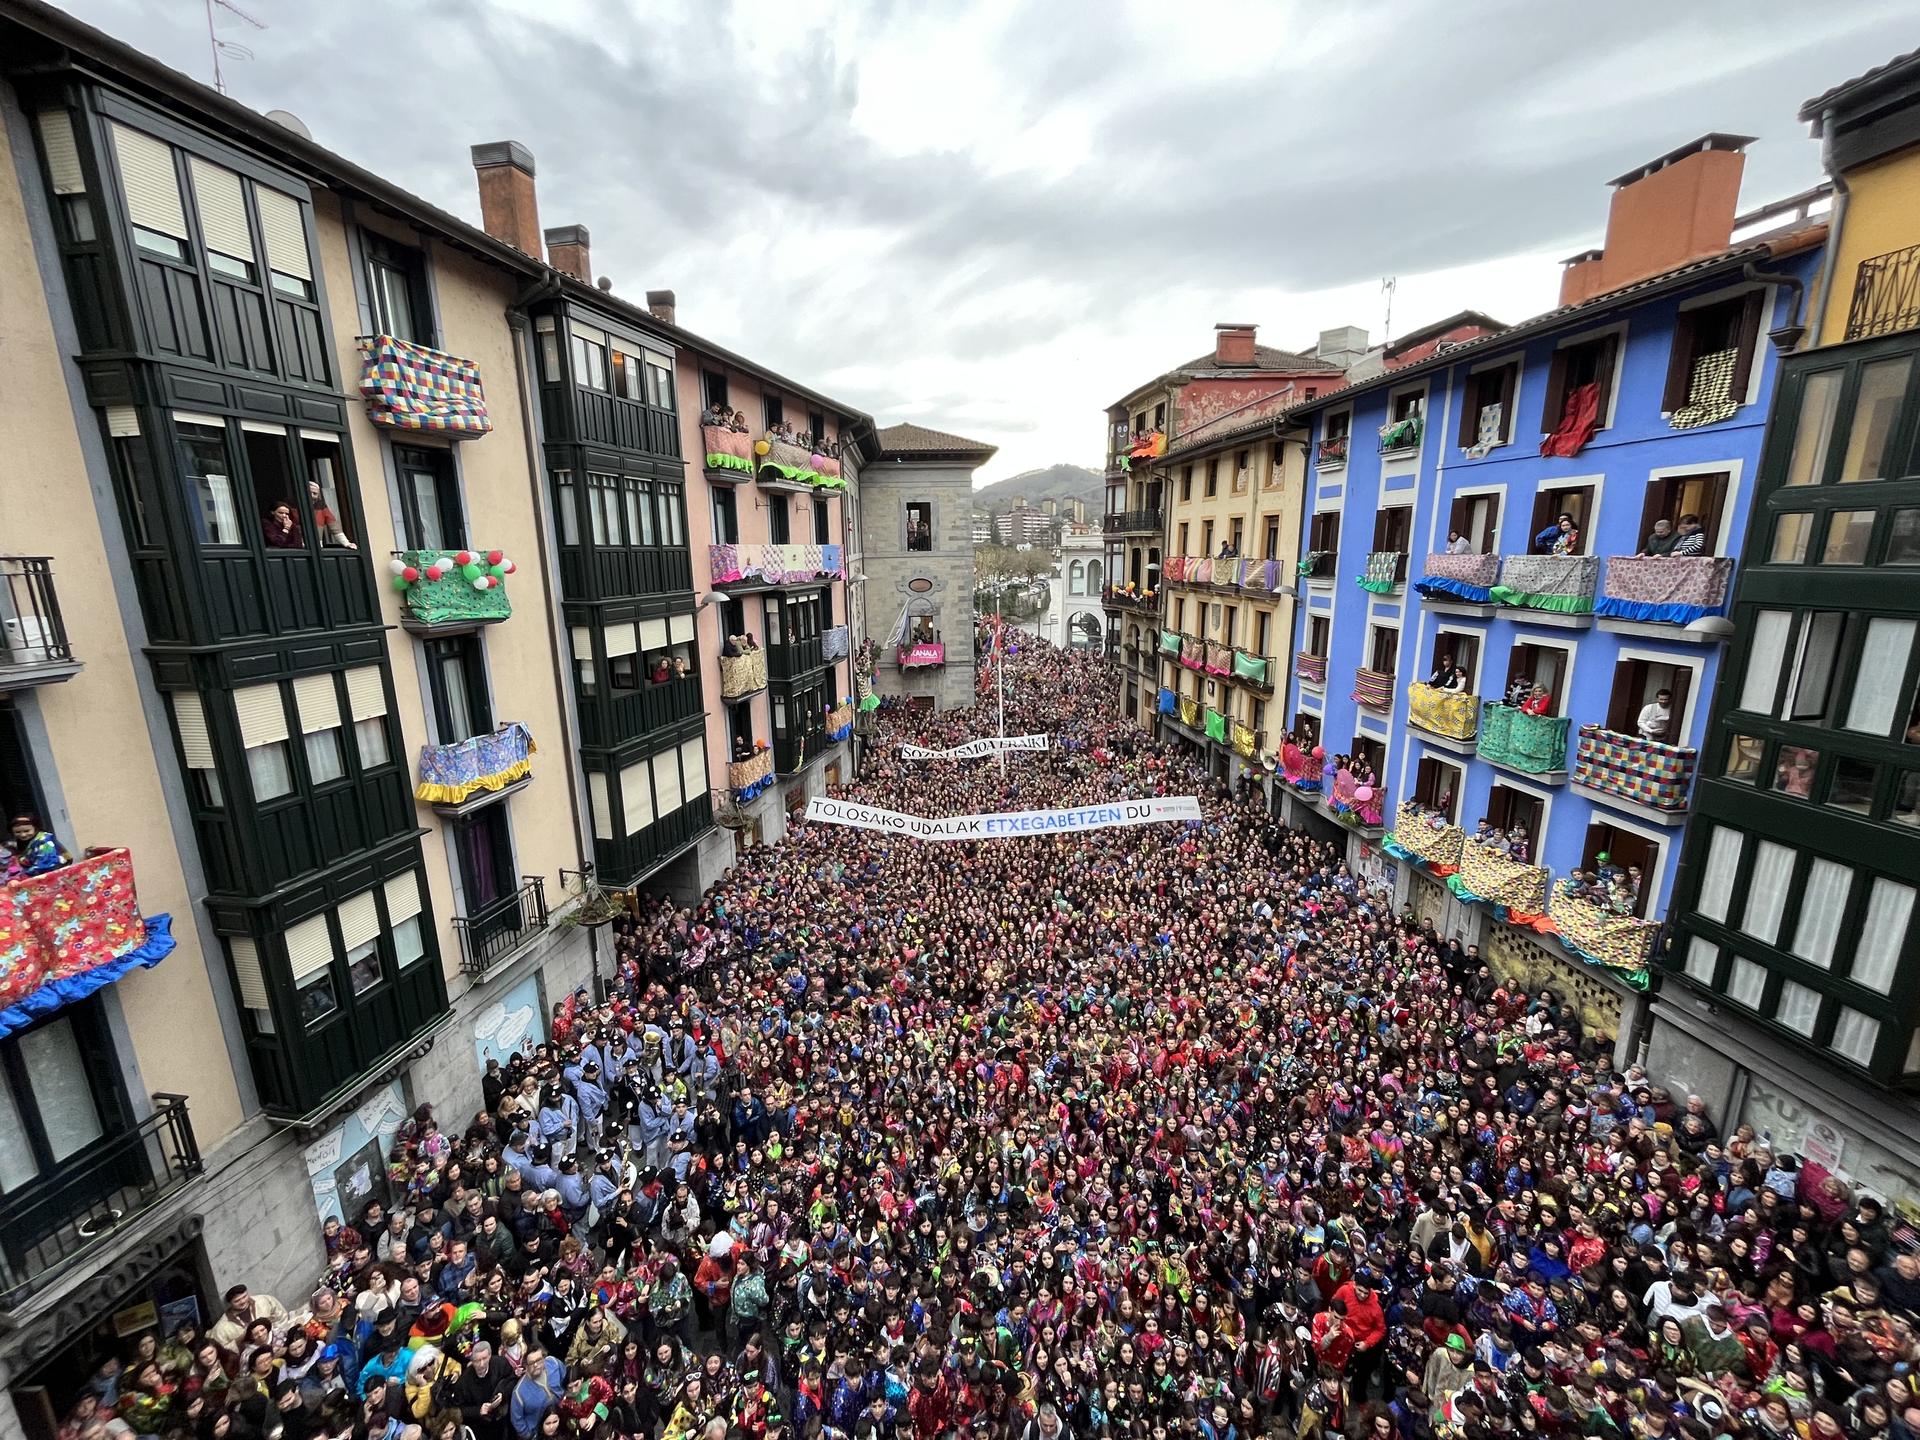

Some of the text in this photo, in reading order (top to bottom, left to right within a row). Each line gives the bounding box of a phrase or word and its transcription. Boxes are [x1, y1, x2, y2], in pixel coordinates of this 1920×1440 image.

[1000, 737, 1047, 748] ERAIKI
[812, 801, 1150, 835] TOLOSAKO UDALAK ETXEGABETZEN DU
